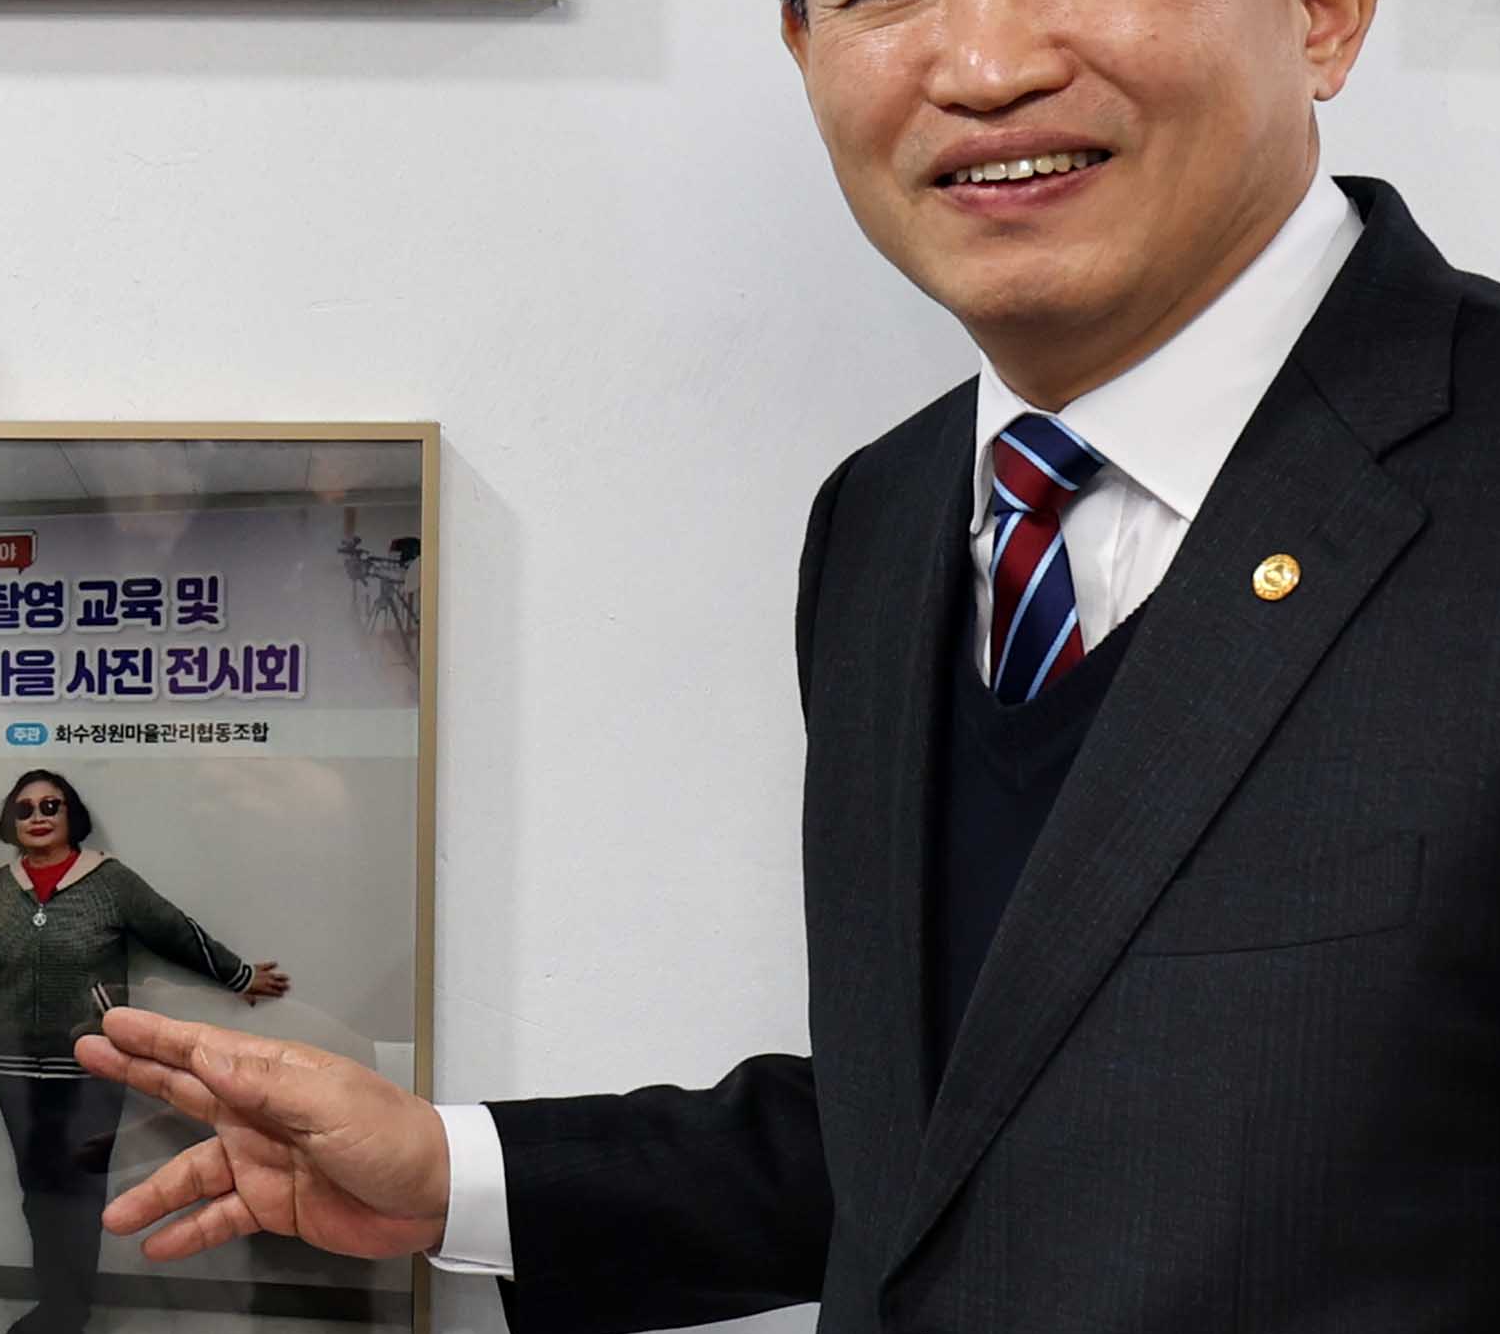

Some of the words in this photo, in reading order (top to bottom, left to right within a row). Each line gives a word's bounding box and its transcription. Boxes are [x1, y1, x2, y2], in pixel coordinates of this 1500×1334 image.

[75, 577, 164, 627] 교육
[176, 575, 220, 625] 및
[66, 646, 153, 696] 사진
[166, 643, 300, 696] 전시회
[13, 726, 42, 743] 주관
